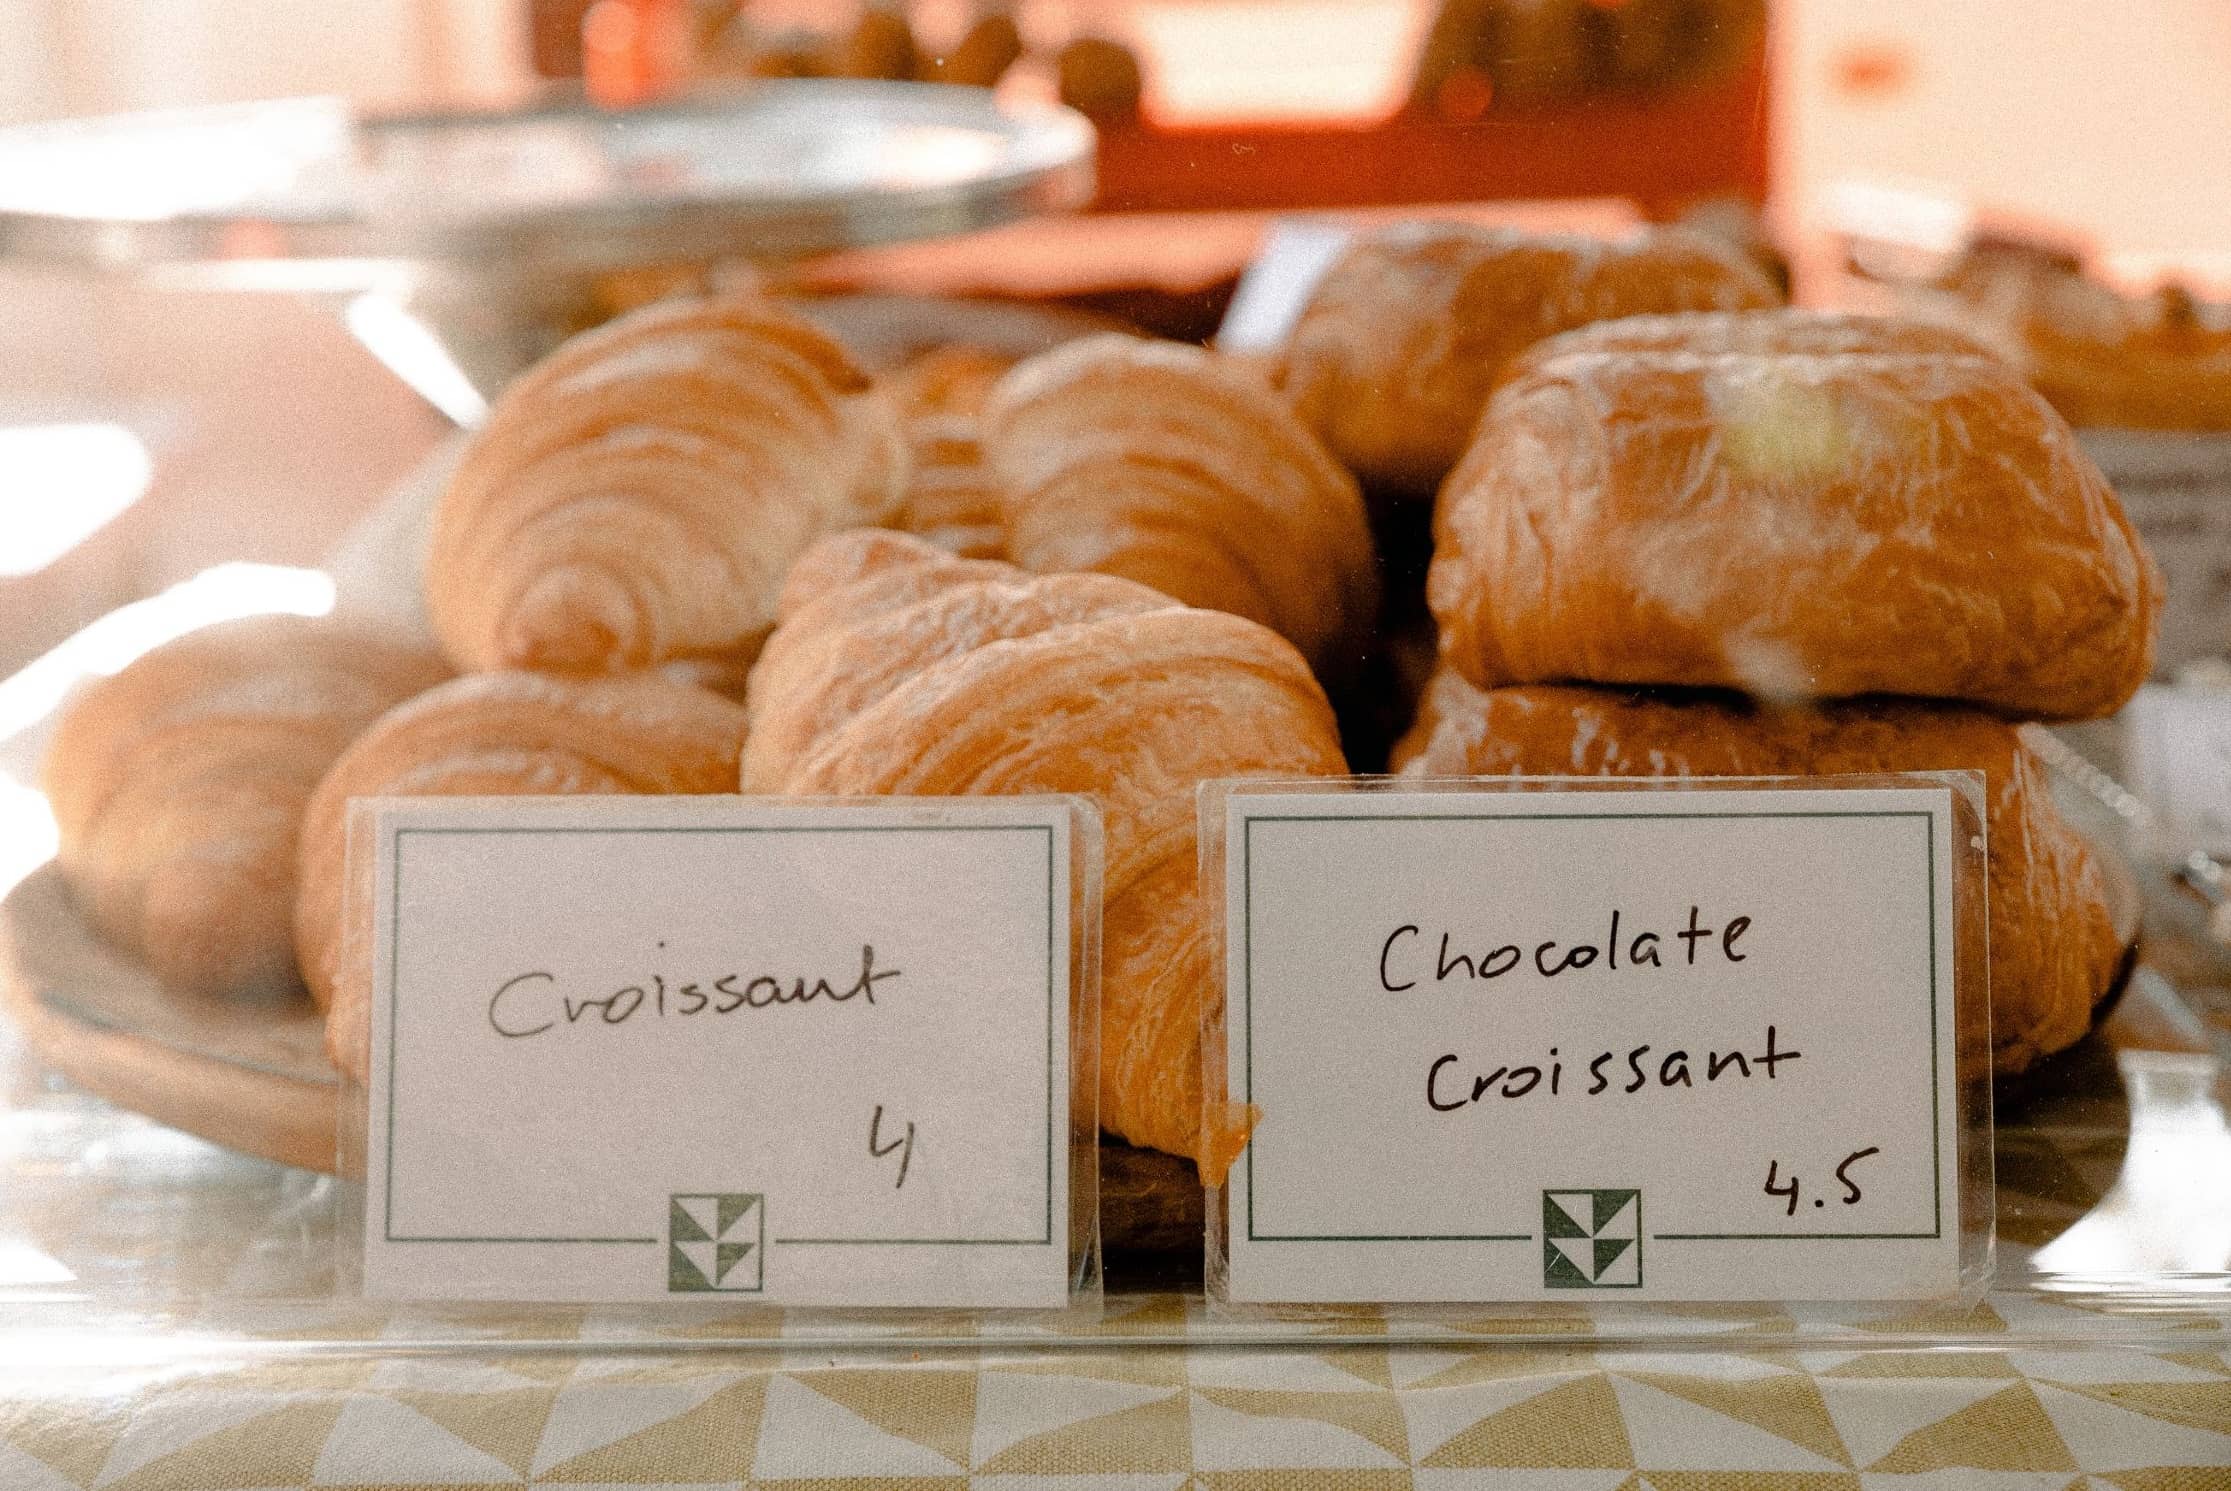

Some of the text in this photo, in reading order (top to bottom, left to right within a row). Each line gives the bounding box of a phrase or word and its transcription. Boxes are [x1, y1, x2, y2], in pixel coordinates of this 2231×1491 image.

[489, 940, 903, 1039] Croissant
[1378, 904, 1753, 994] Chocolate
[1425, 1023, 1803, 1114] Croissant
[868, 1103, 916, 1190] 4
[1762, 1145, 1881, 1218] 4.5
